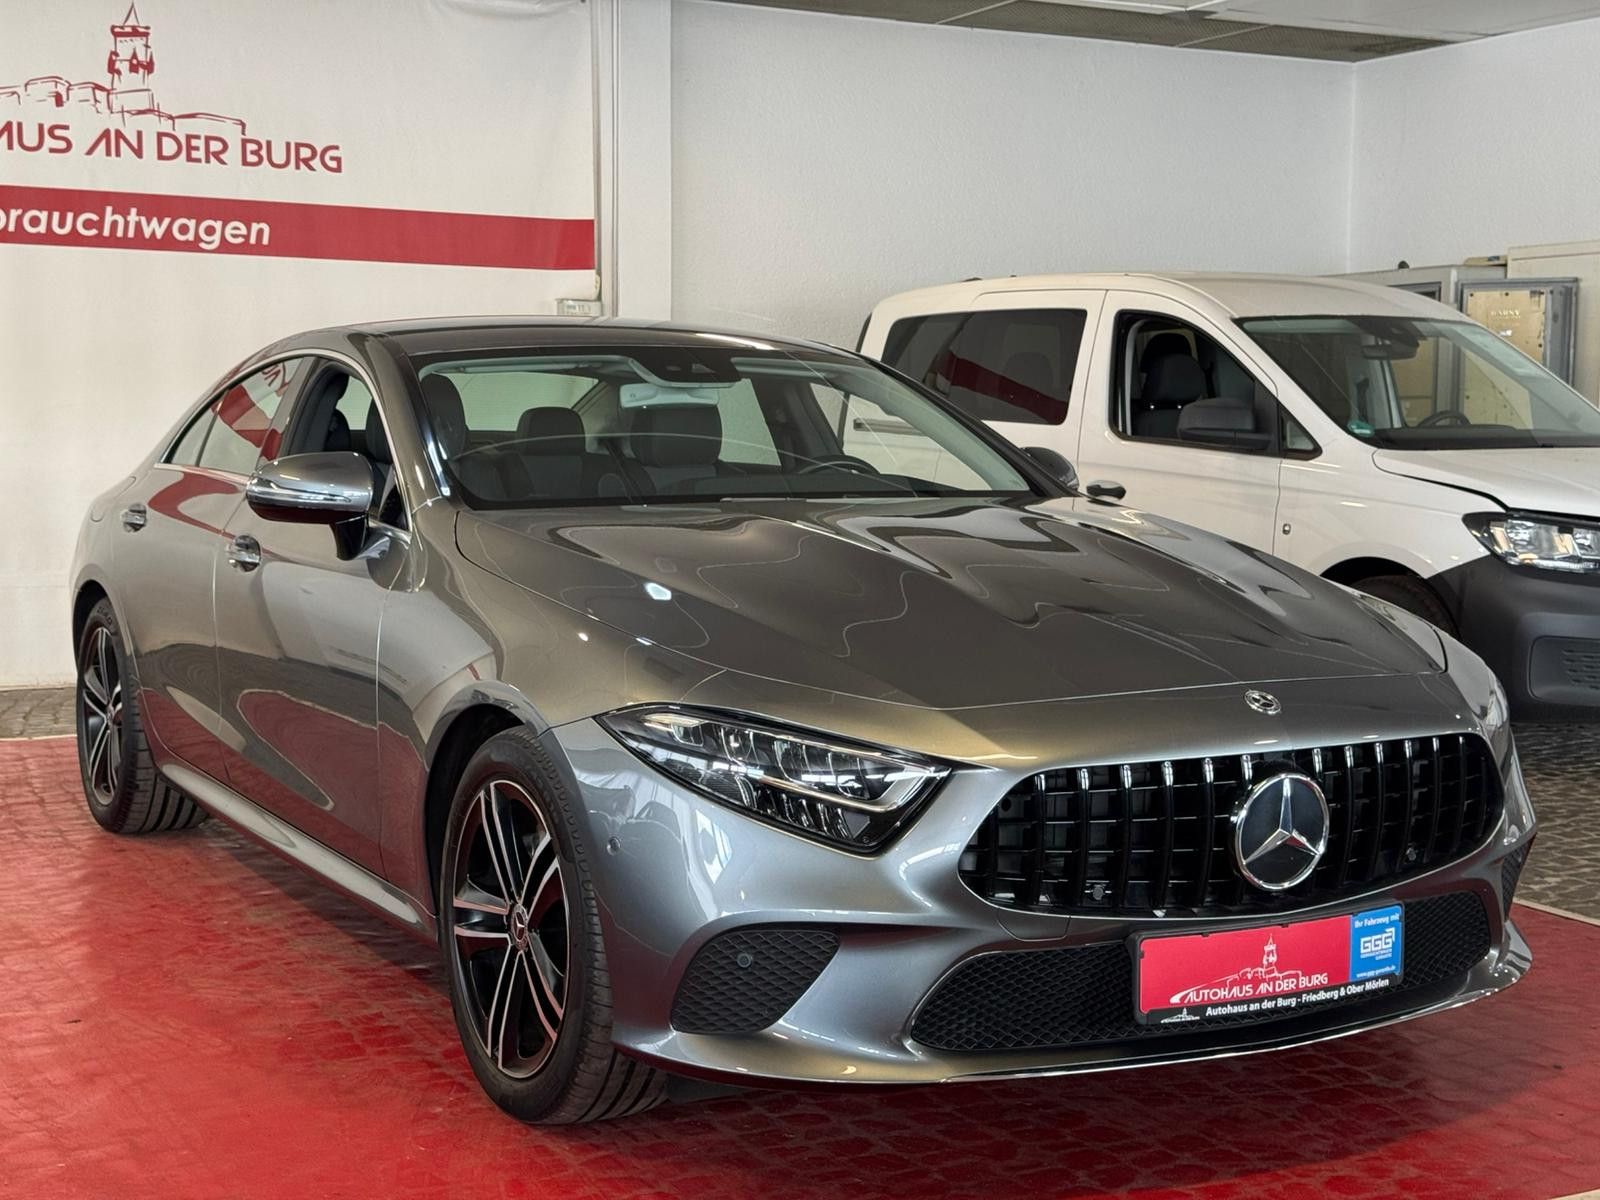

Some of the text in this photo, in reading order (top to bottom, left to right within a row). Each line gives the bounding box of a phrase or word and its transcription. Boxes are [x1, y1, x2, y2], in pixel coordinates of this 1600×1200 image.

[84, 127, 144, 160] AN
[156, 131, 229, 165] DER
[240, 138, 343, 173] BURG
[1360, 932, 1393, 954] GGG
[1184, 973, 1328, 1004] AUTOHAUS AN DER BURG
[1205, 1003, 1248, 1016] Autohaus
[1249, 1002, 1260, 1011] an
[1261, 999, 1276, 1009] der
[1277, 996, 1296, 1008] Burg
[1302, 989, 1339, 1003] Friedberg
[1339, 987, 1346, 997] &
[1346, 983, 1365, 995] Ober
[1365, 978, 1389, 991] Mörlen
